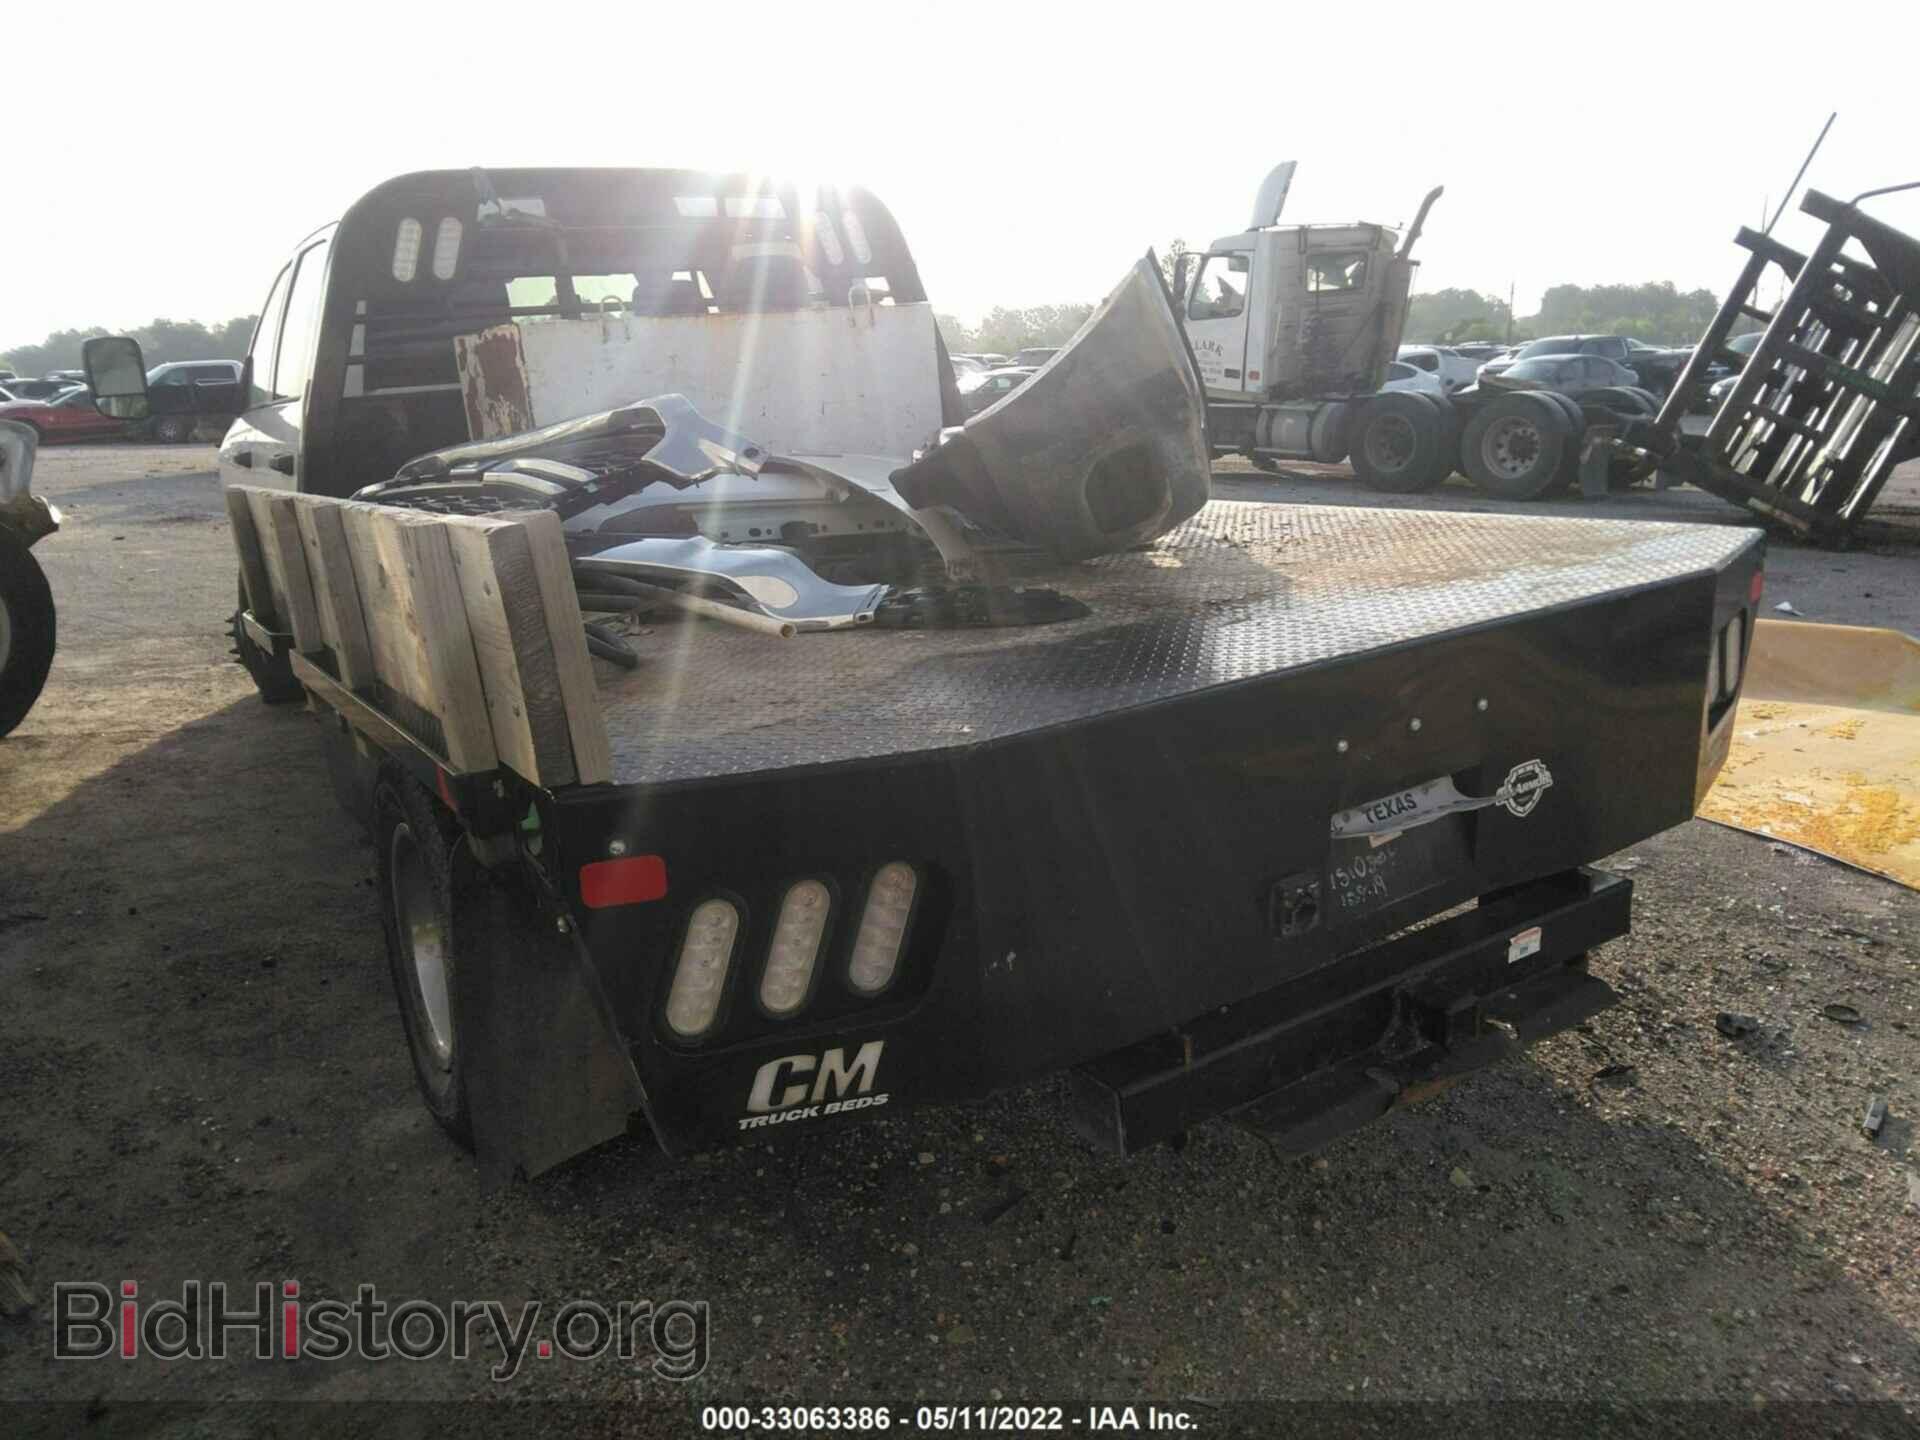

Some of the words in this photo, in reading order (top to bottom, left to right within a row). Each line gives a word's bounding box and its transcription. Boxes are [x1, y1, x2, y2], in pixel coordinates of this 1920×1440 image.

[1362, 792, 1417, 823] TEXAS
[746, 1040, 884, 1112] CM
[738, 1105, 821, 1130] TRUCK
[823, 1093, 889, 1115] BEDS
